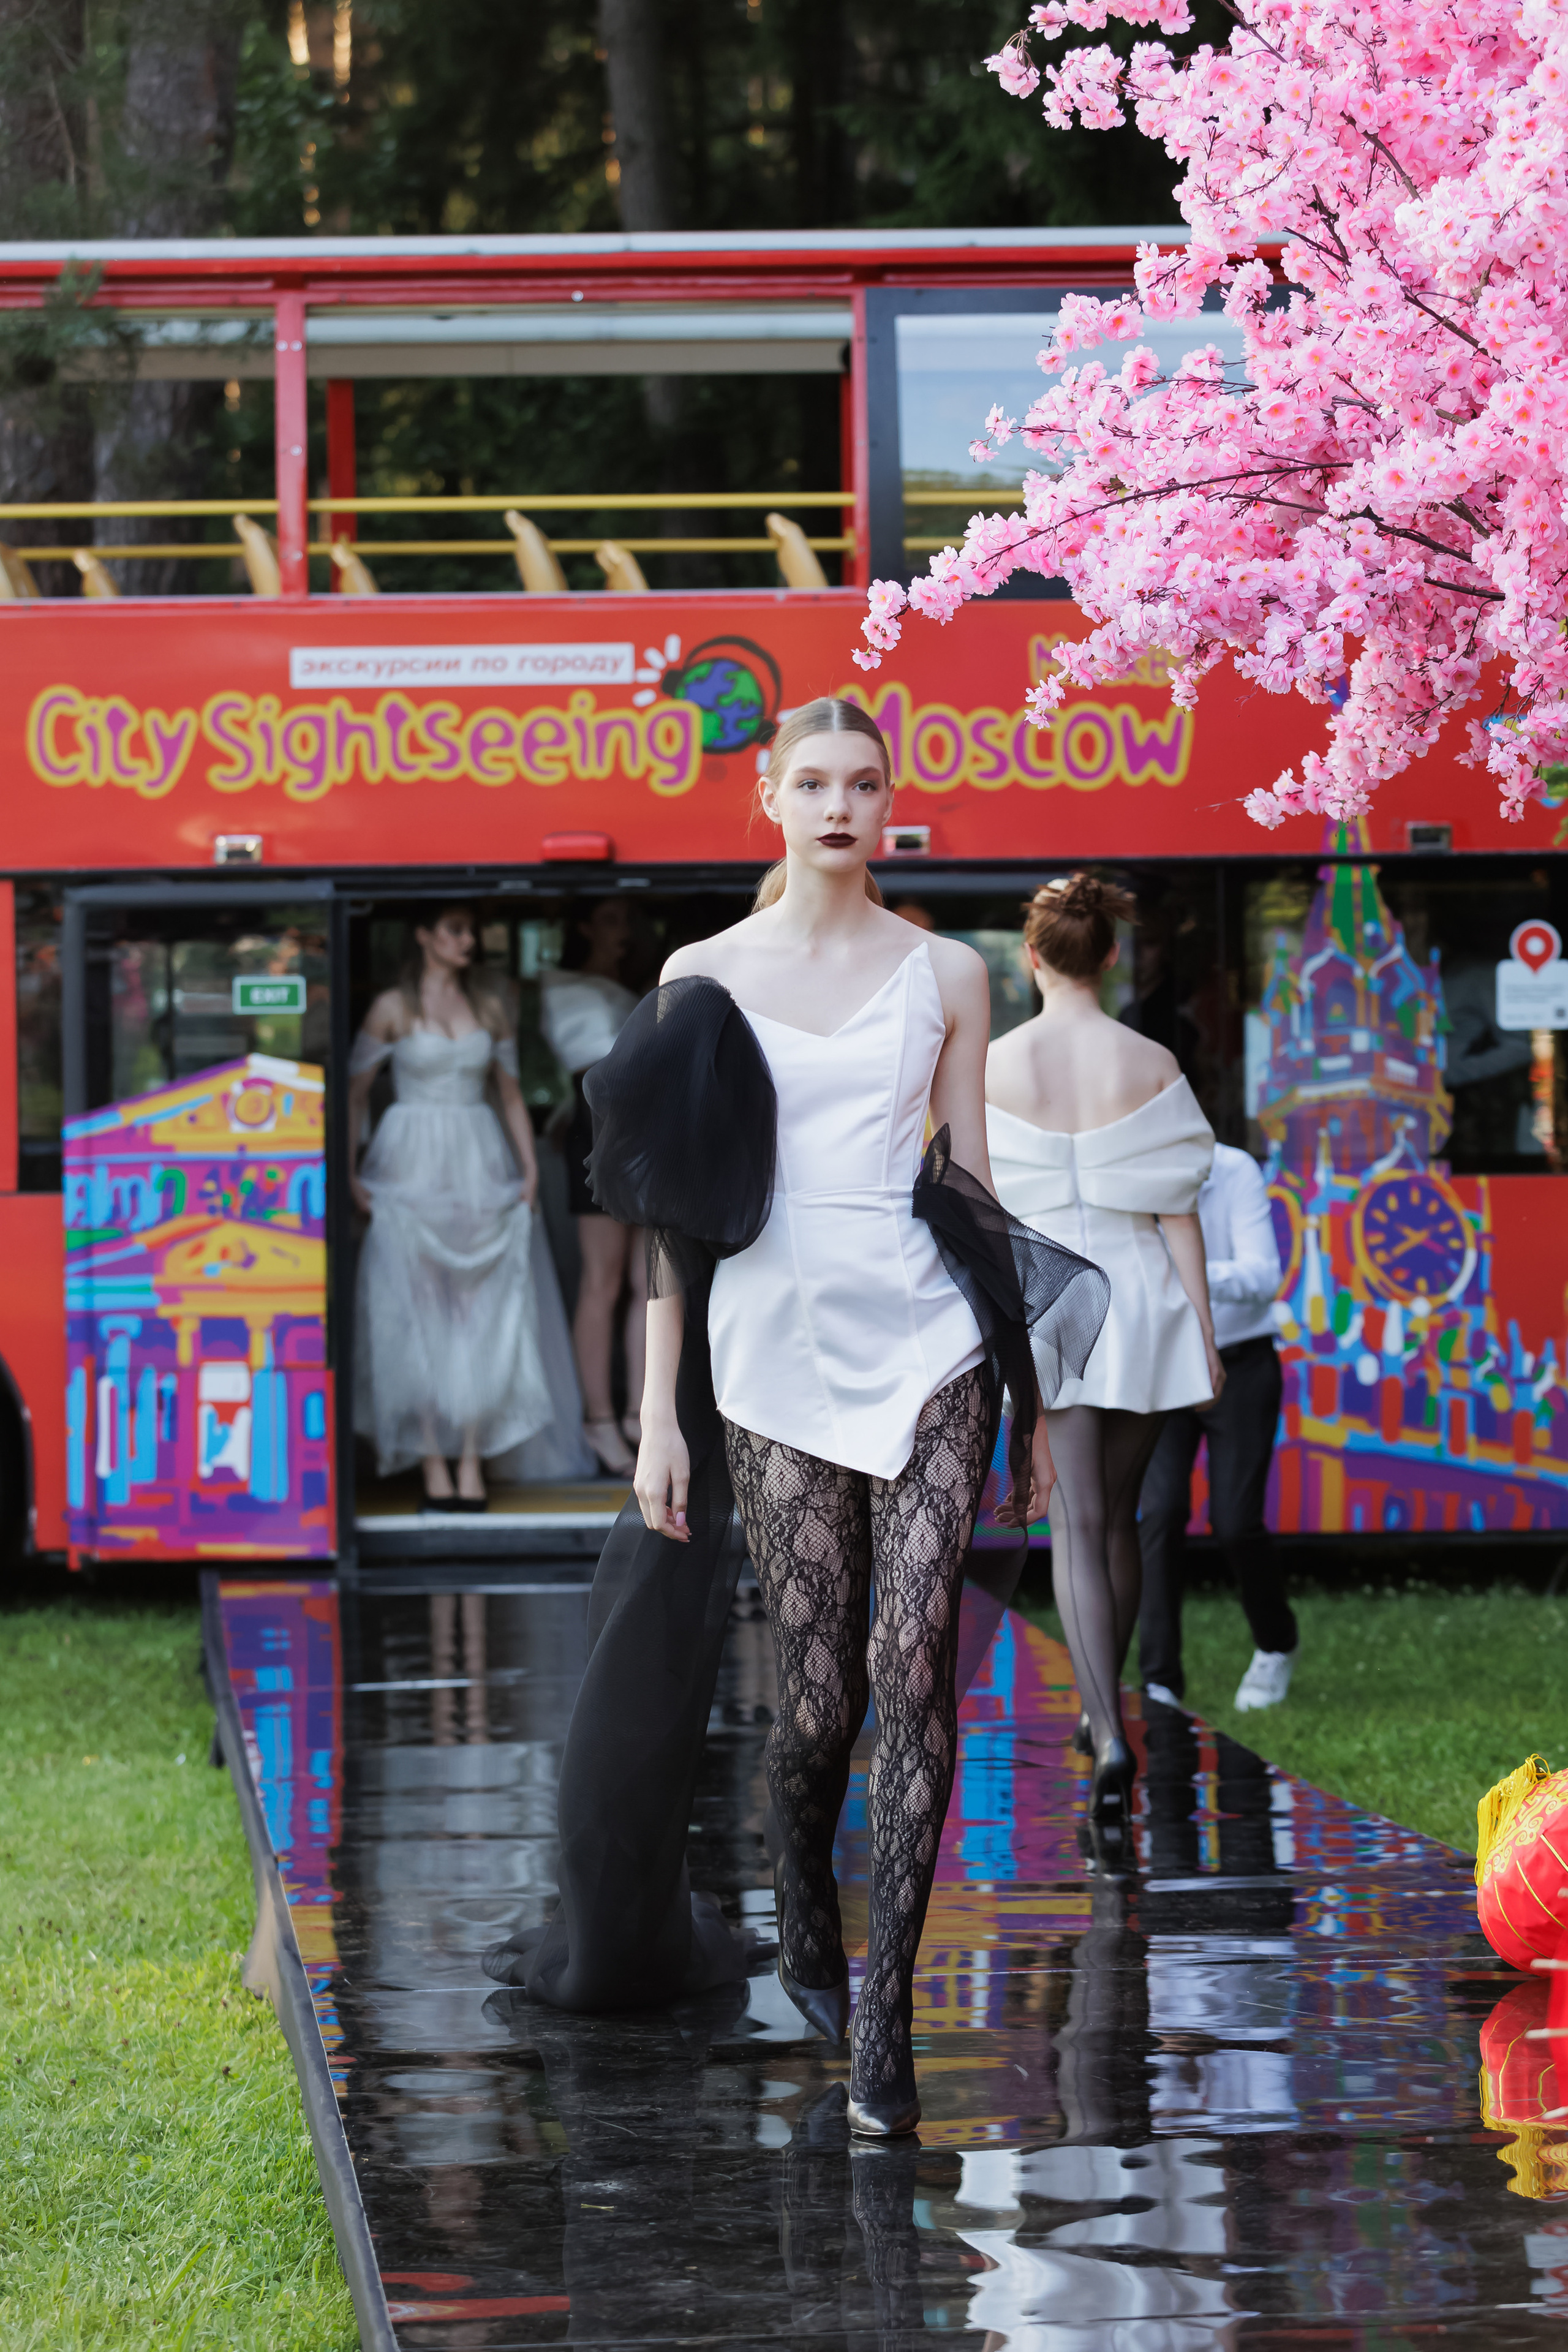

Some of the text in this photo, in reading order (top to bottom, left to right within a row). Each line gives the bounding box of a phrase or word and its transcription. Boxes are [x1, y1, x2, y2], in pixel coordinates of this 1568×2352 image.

[470, 655, 509, 673] по
[517, 653, 626, 677] городу
[26, 684, 198, 799] City
[201, 689, 703, 802] Sightseeing
[250, 986, 290, 1005] EXIT
